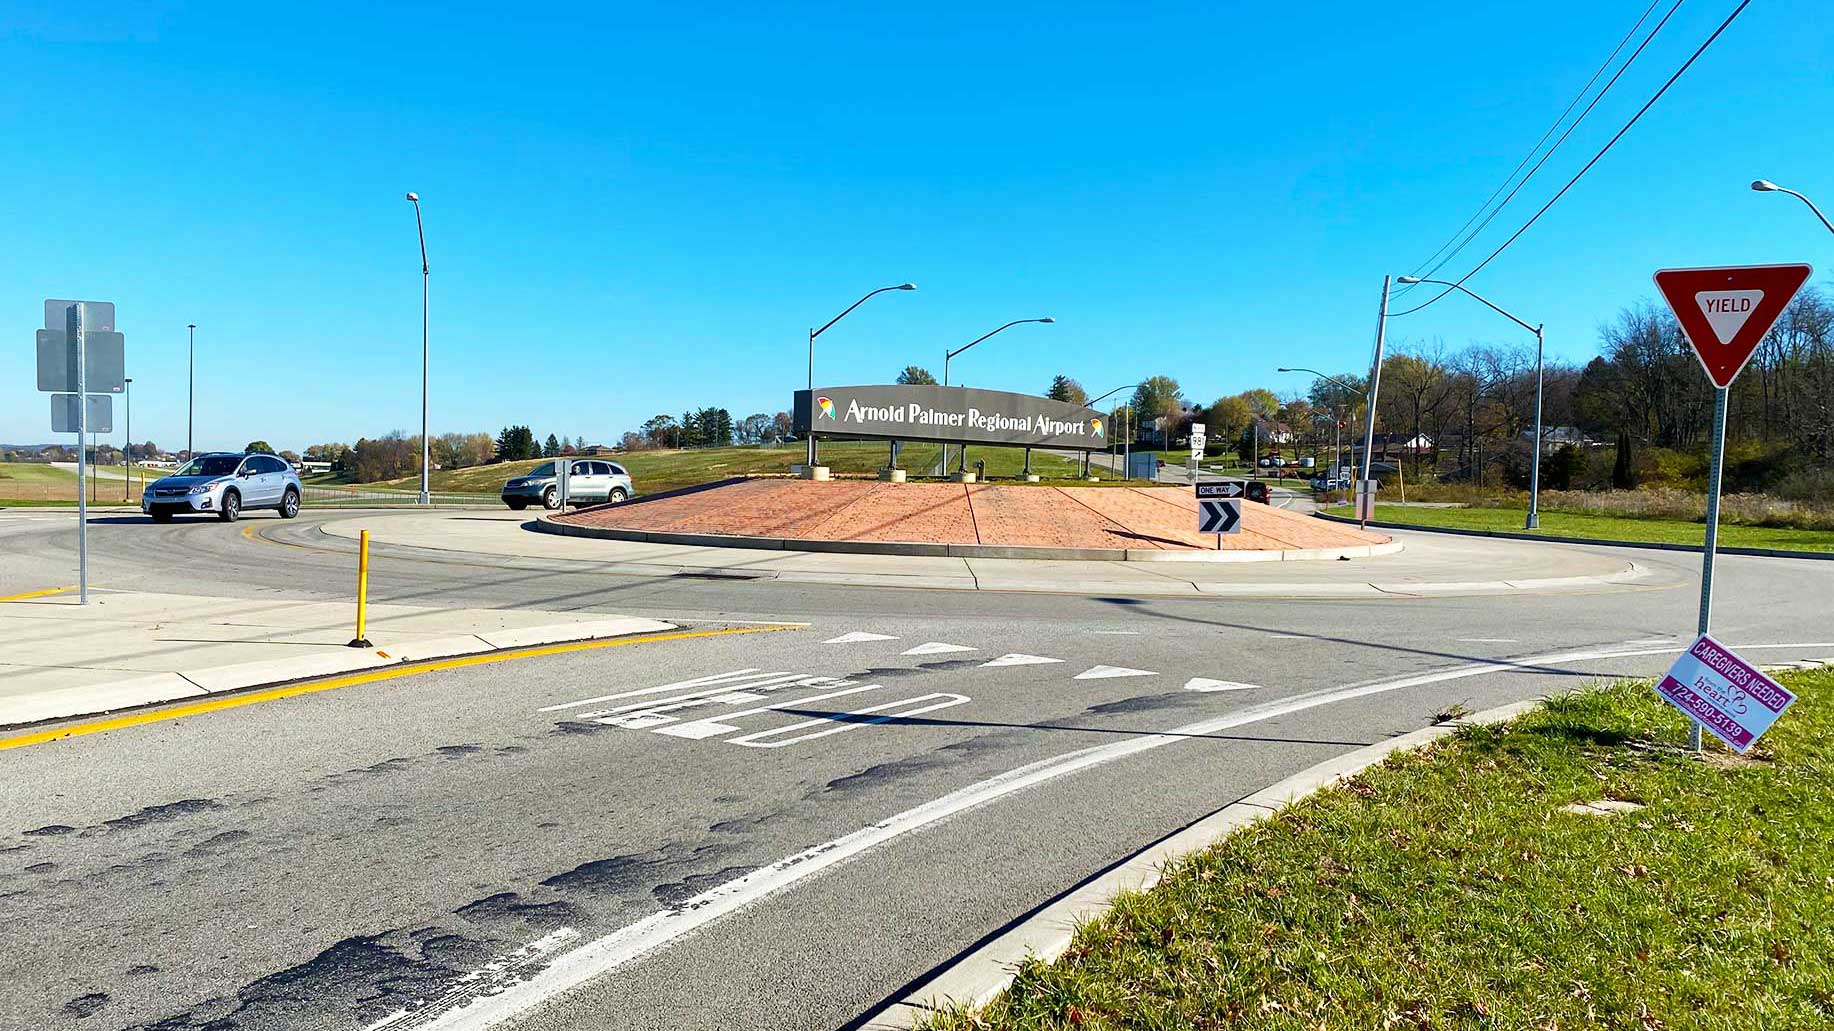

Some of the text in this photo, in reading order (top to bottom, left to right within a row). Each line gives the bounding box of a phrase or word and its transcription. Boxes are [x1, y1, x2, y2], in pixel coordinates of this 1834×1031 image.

[1706, 298, 1751, 313] YIELD
[844, 398, 1085, 436] Arnold Palmer Regional Airport
[1694, 641, 1752, 686] CAREGIVERS
[1747, 677, 1786, 710] NEEDED
[1694, 675, 1731, 708] heart
[1672, 683, 1743, 737] 724-590-5139
